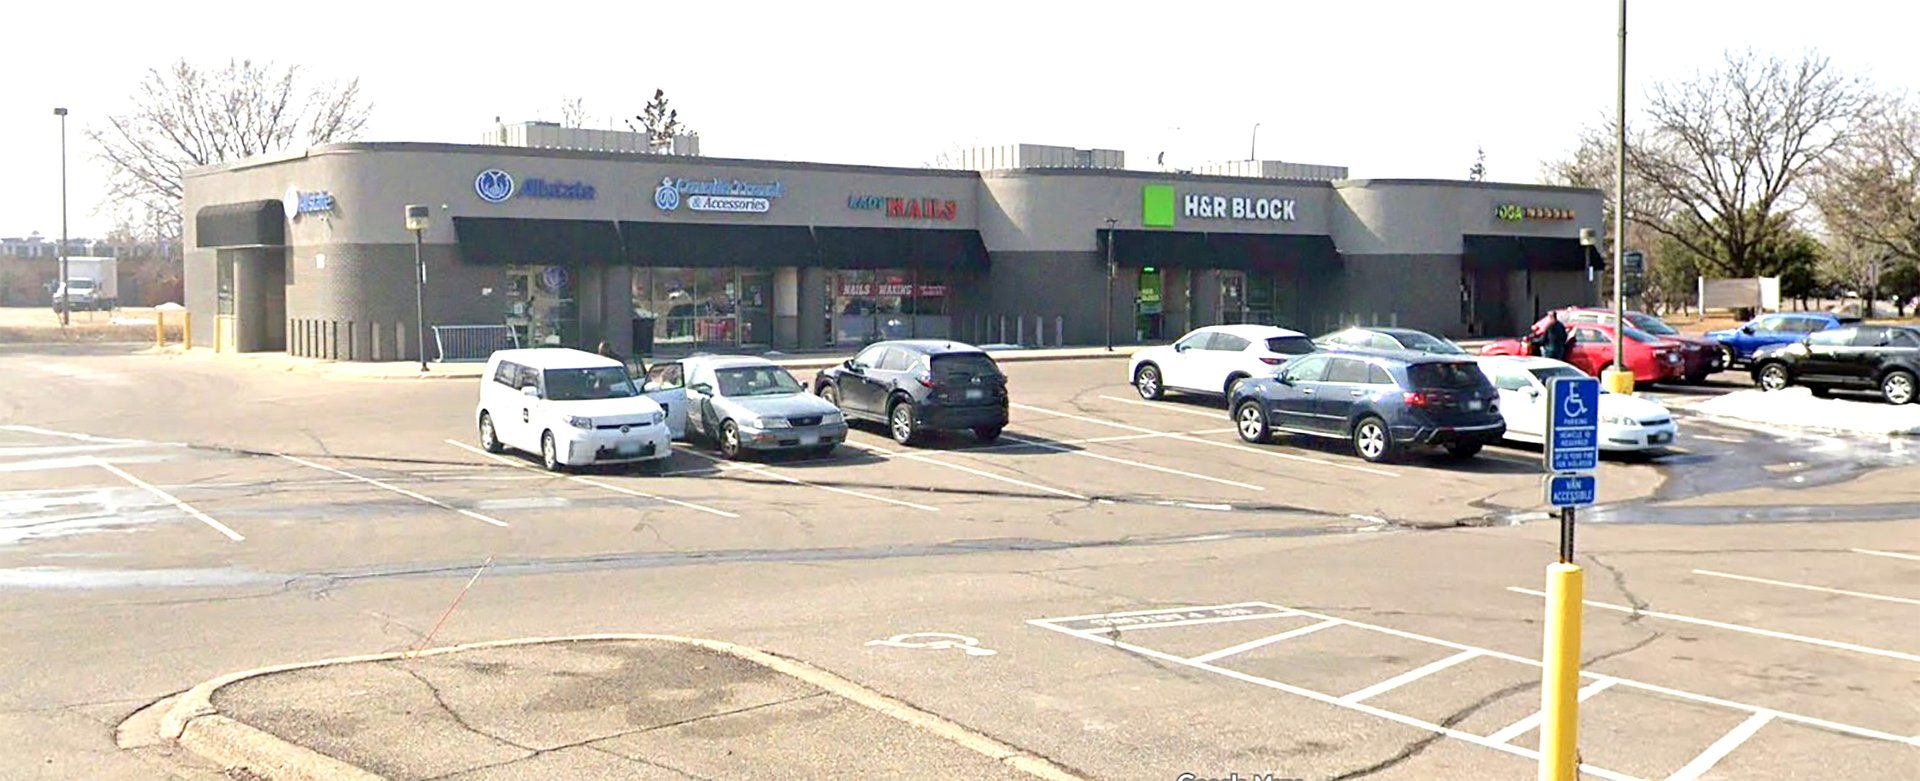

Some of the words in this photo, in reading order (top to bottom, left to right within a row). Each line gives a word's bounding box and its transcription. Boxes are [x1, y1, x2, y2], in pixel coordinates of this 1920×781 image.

[703, 198, 766, 210] Accessories
[886, 197, 956, 220] NAILS
[1185, 195, 1226, 218] H&R
[1232, 198, 1296, 220] BLOCK
[843, 283, 870, 296] NAILS
[878, 284, 913, 296] WAXING
[1566, 481, 1582, 489] VAN
[1553, 490, 1593, 501] ACCESSIBLE
